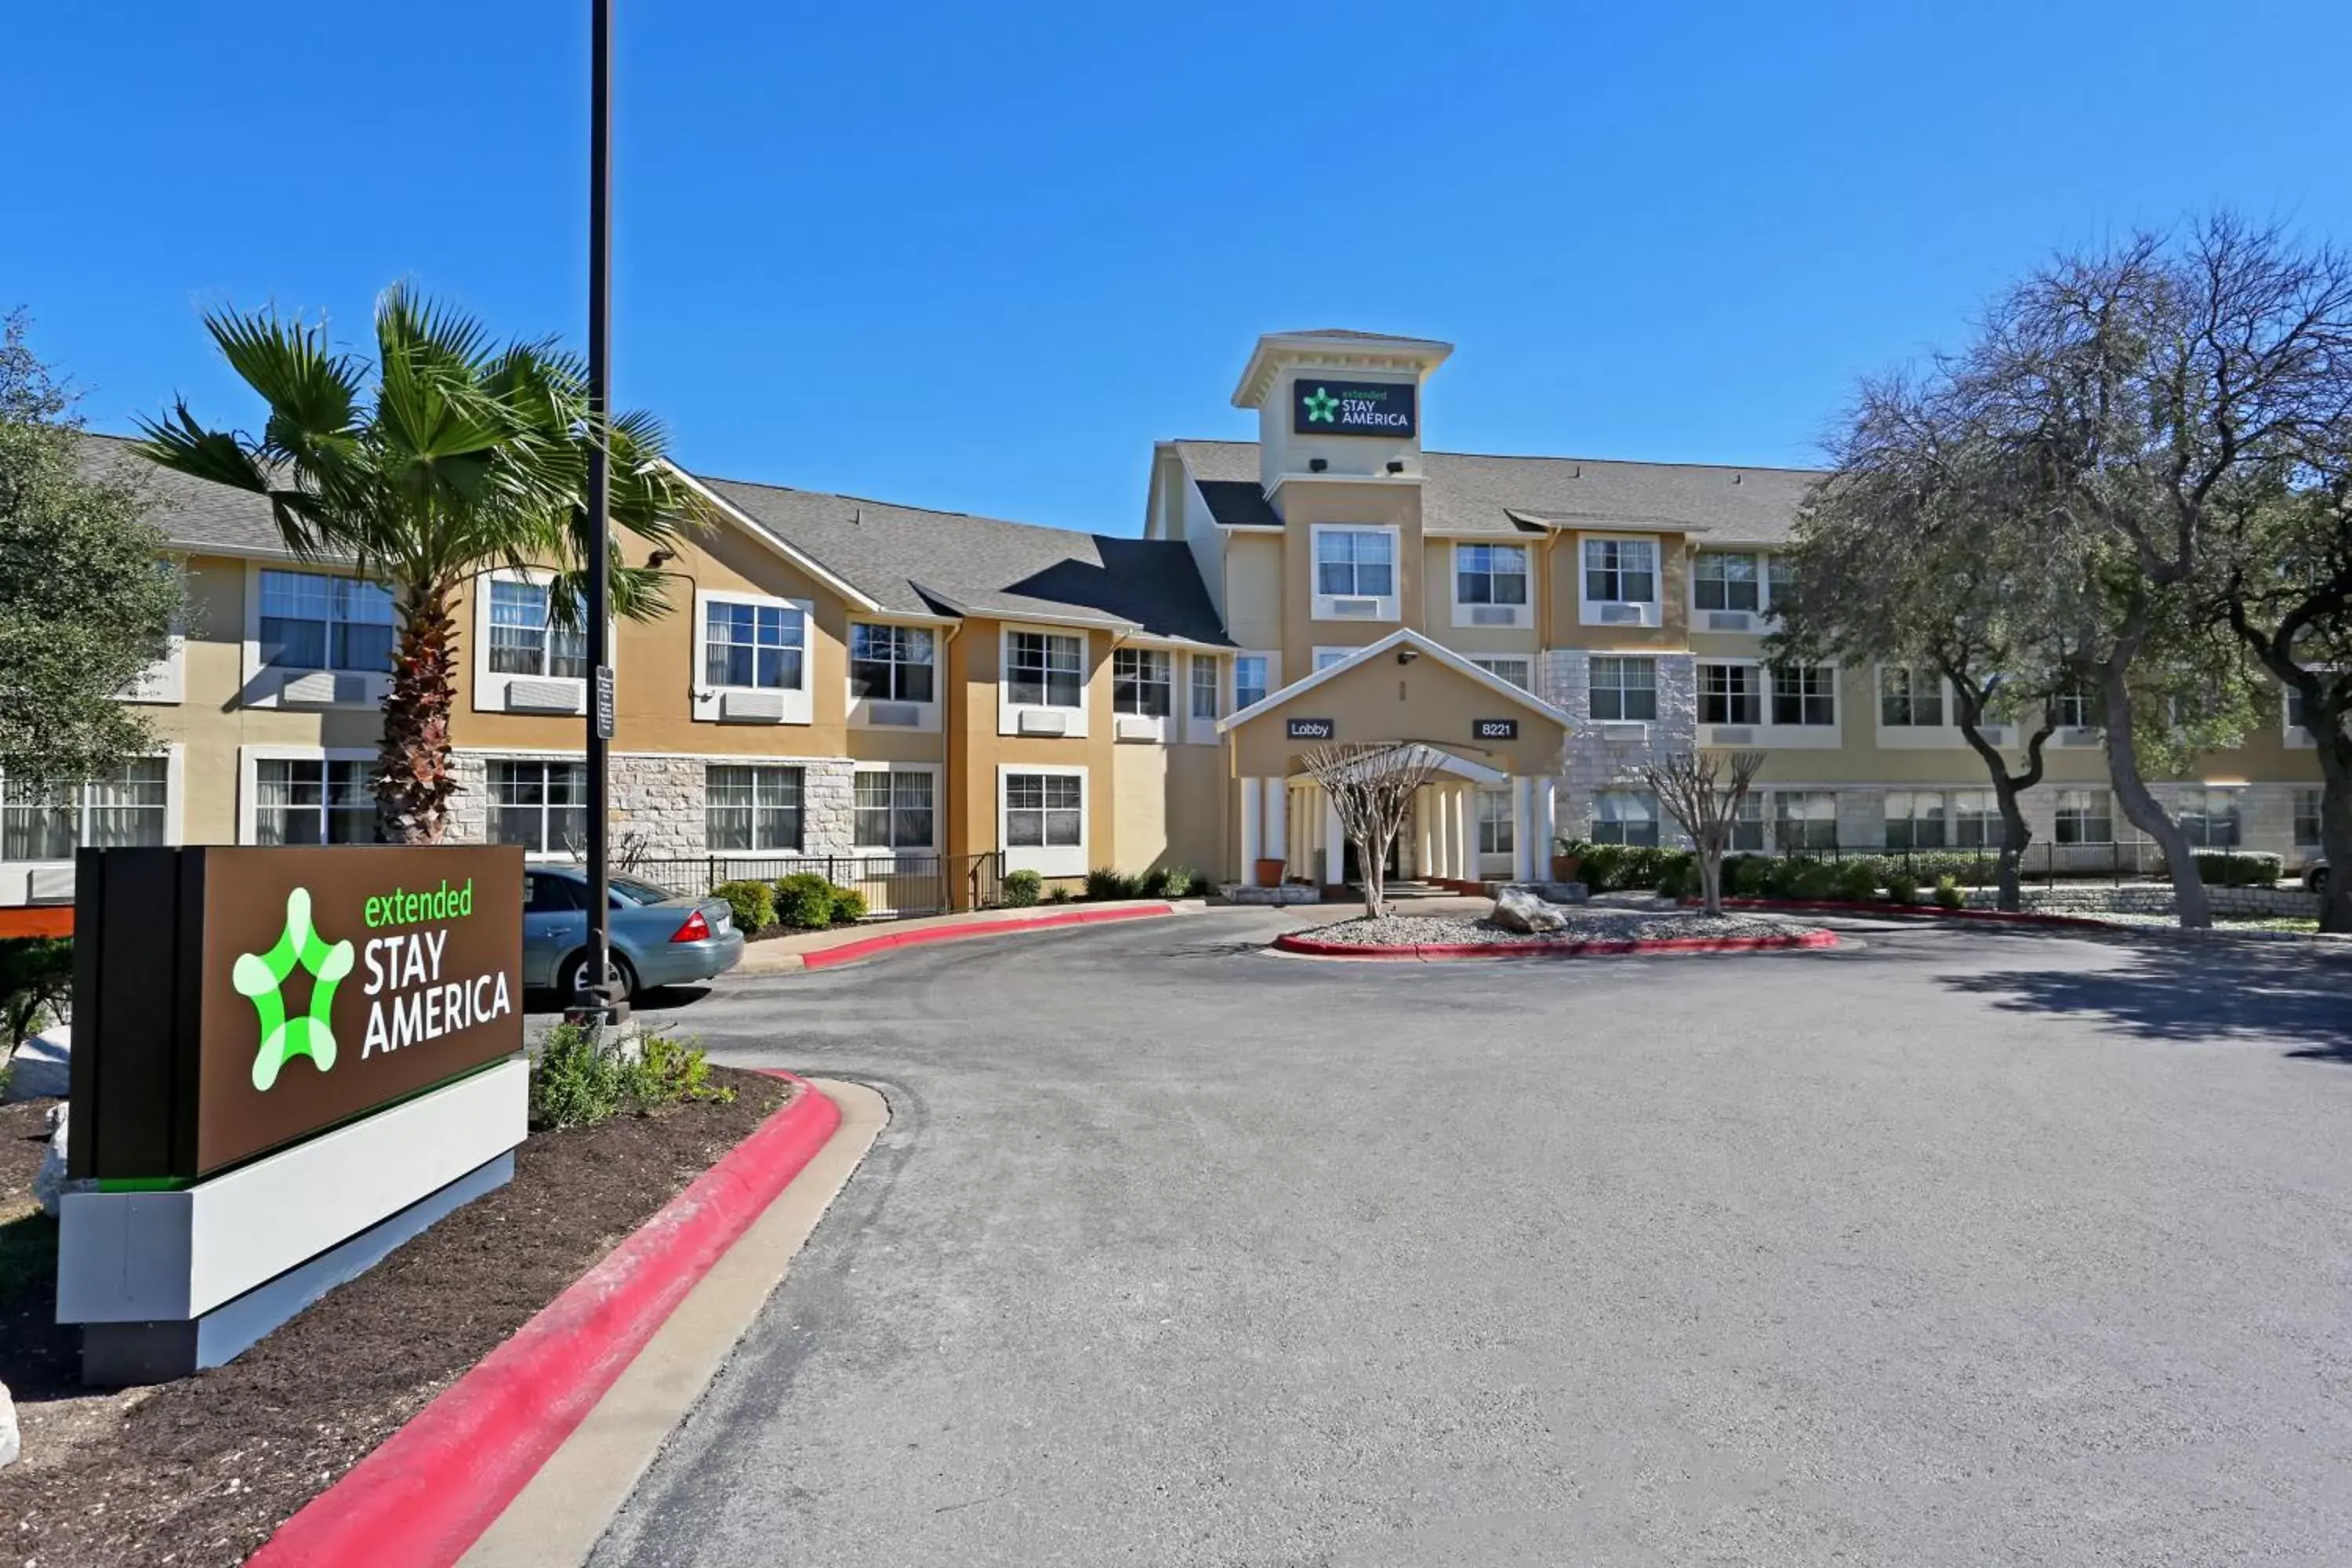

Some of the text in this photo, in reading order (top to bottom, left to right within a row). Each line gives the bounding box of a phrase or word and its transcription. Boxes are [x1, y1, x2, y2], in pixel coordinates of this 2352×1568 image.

[1341, 399, 1376, 412] STAY
[1341, 412, 1408, 426] AMERICA
[1291, 723, 1329, 737] Lobby
[1482, 723, 1510, 735] 8221
[364, 878, 473, 927] extended
[363, 930, 448, 996] STAY
[361, 971, 510, 1060] AMERICA
